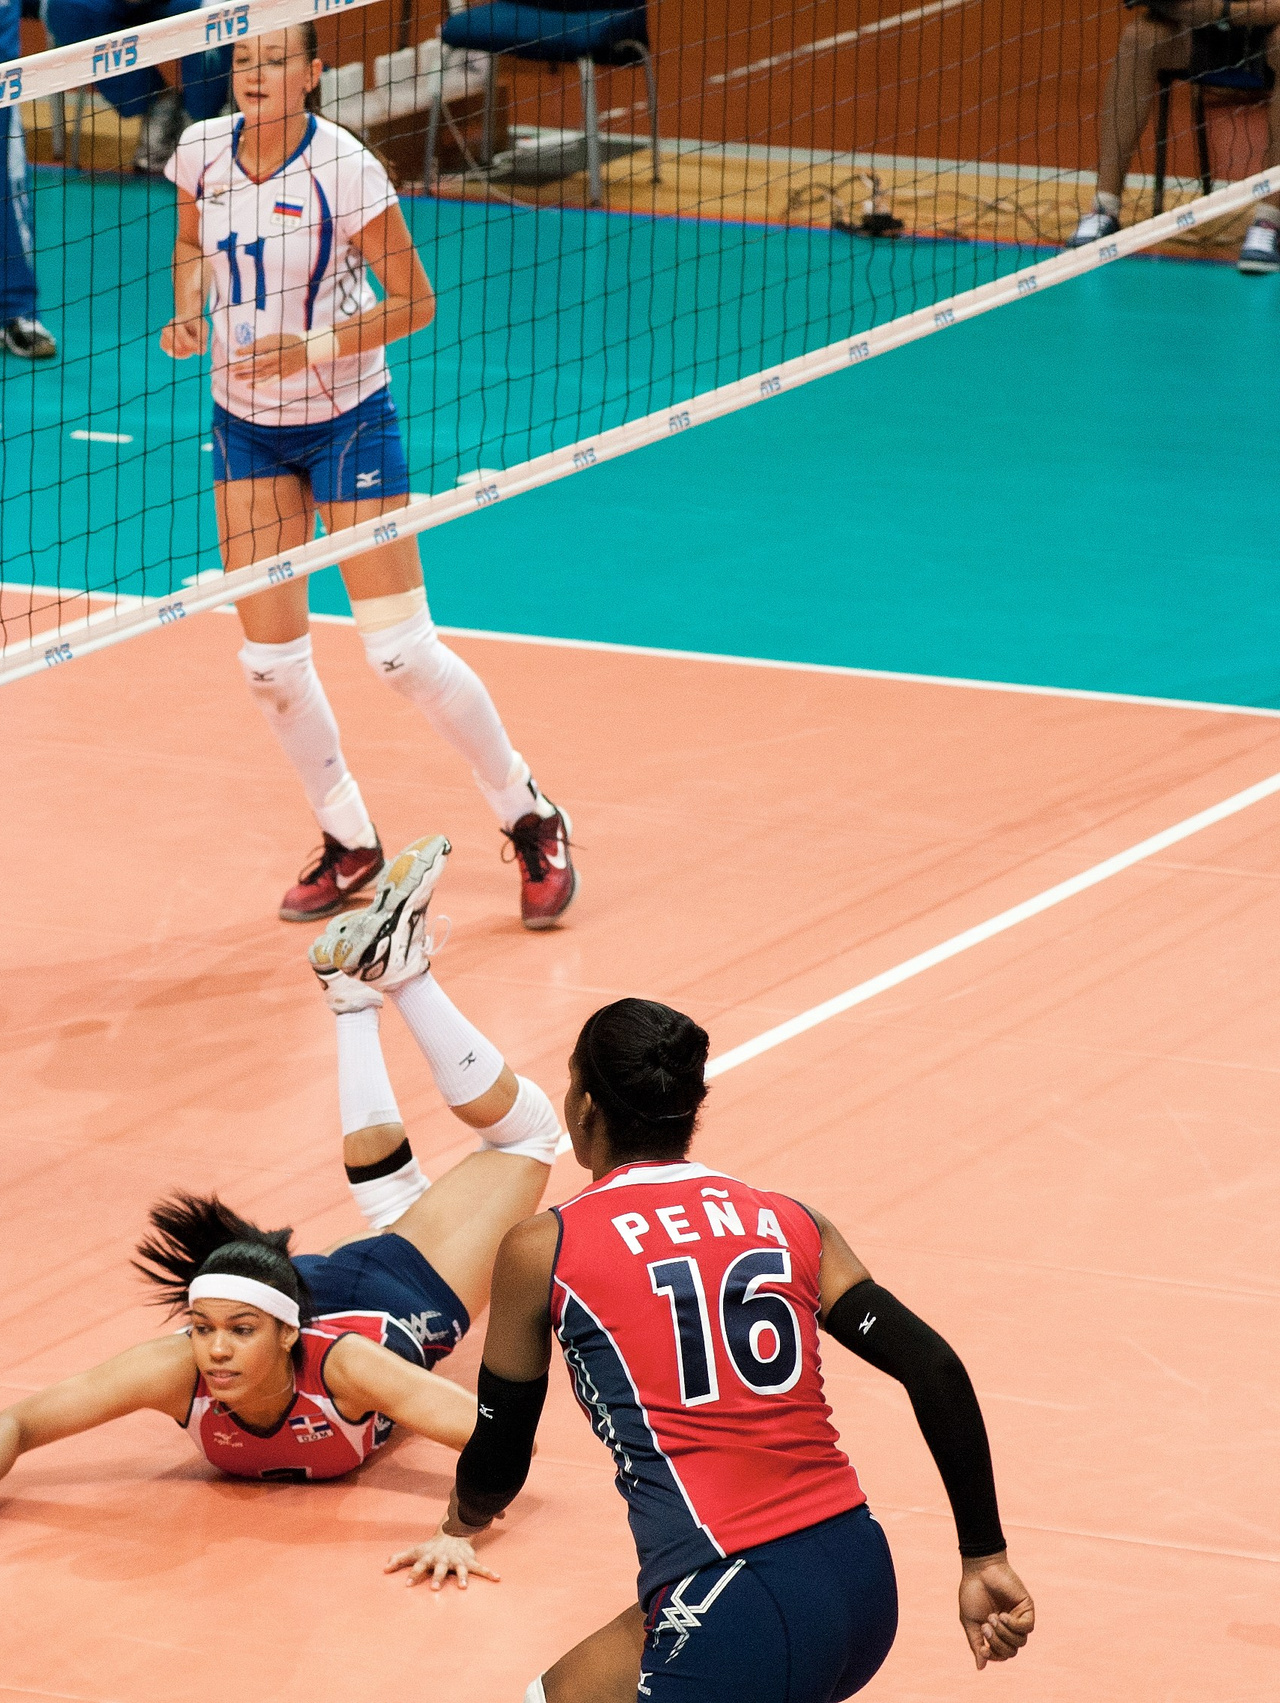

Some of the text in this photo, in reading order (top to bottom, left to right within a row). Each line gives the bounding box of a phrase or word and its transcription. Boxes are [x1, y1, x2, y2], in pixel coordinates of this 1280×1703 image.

[217, 231, 266, 311] 11
[610, 1187, 789, 1255] PEÑA
[646, 1248, 802, 1407] 16
[301, 1431, 329, 1442] DOM
